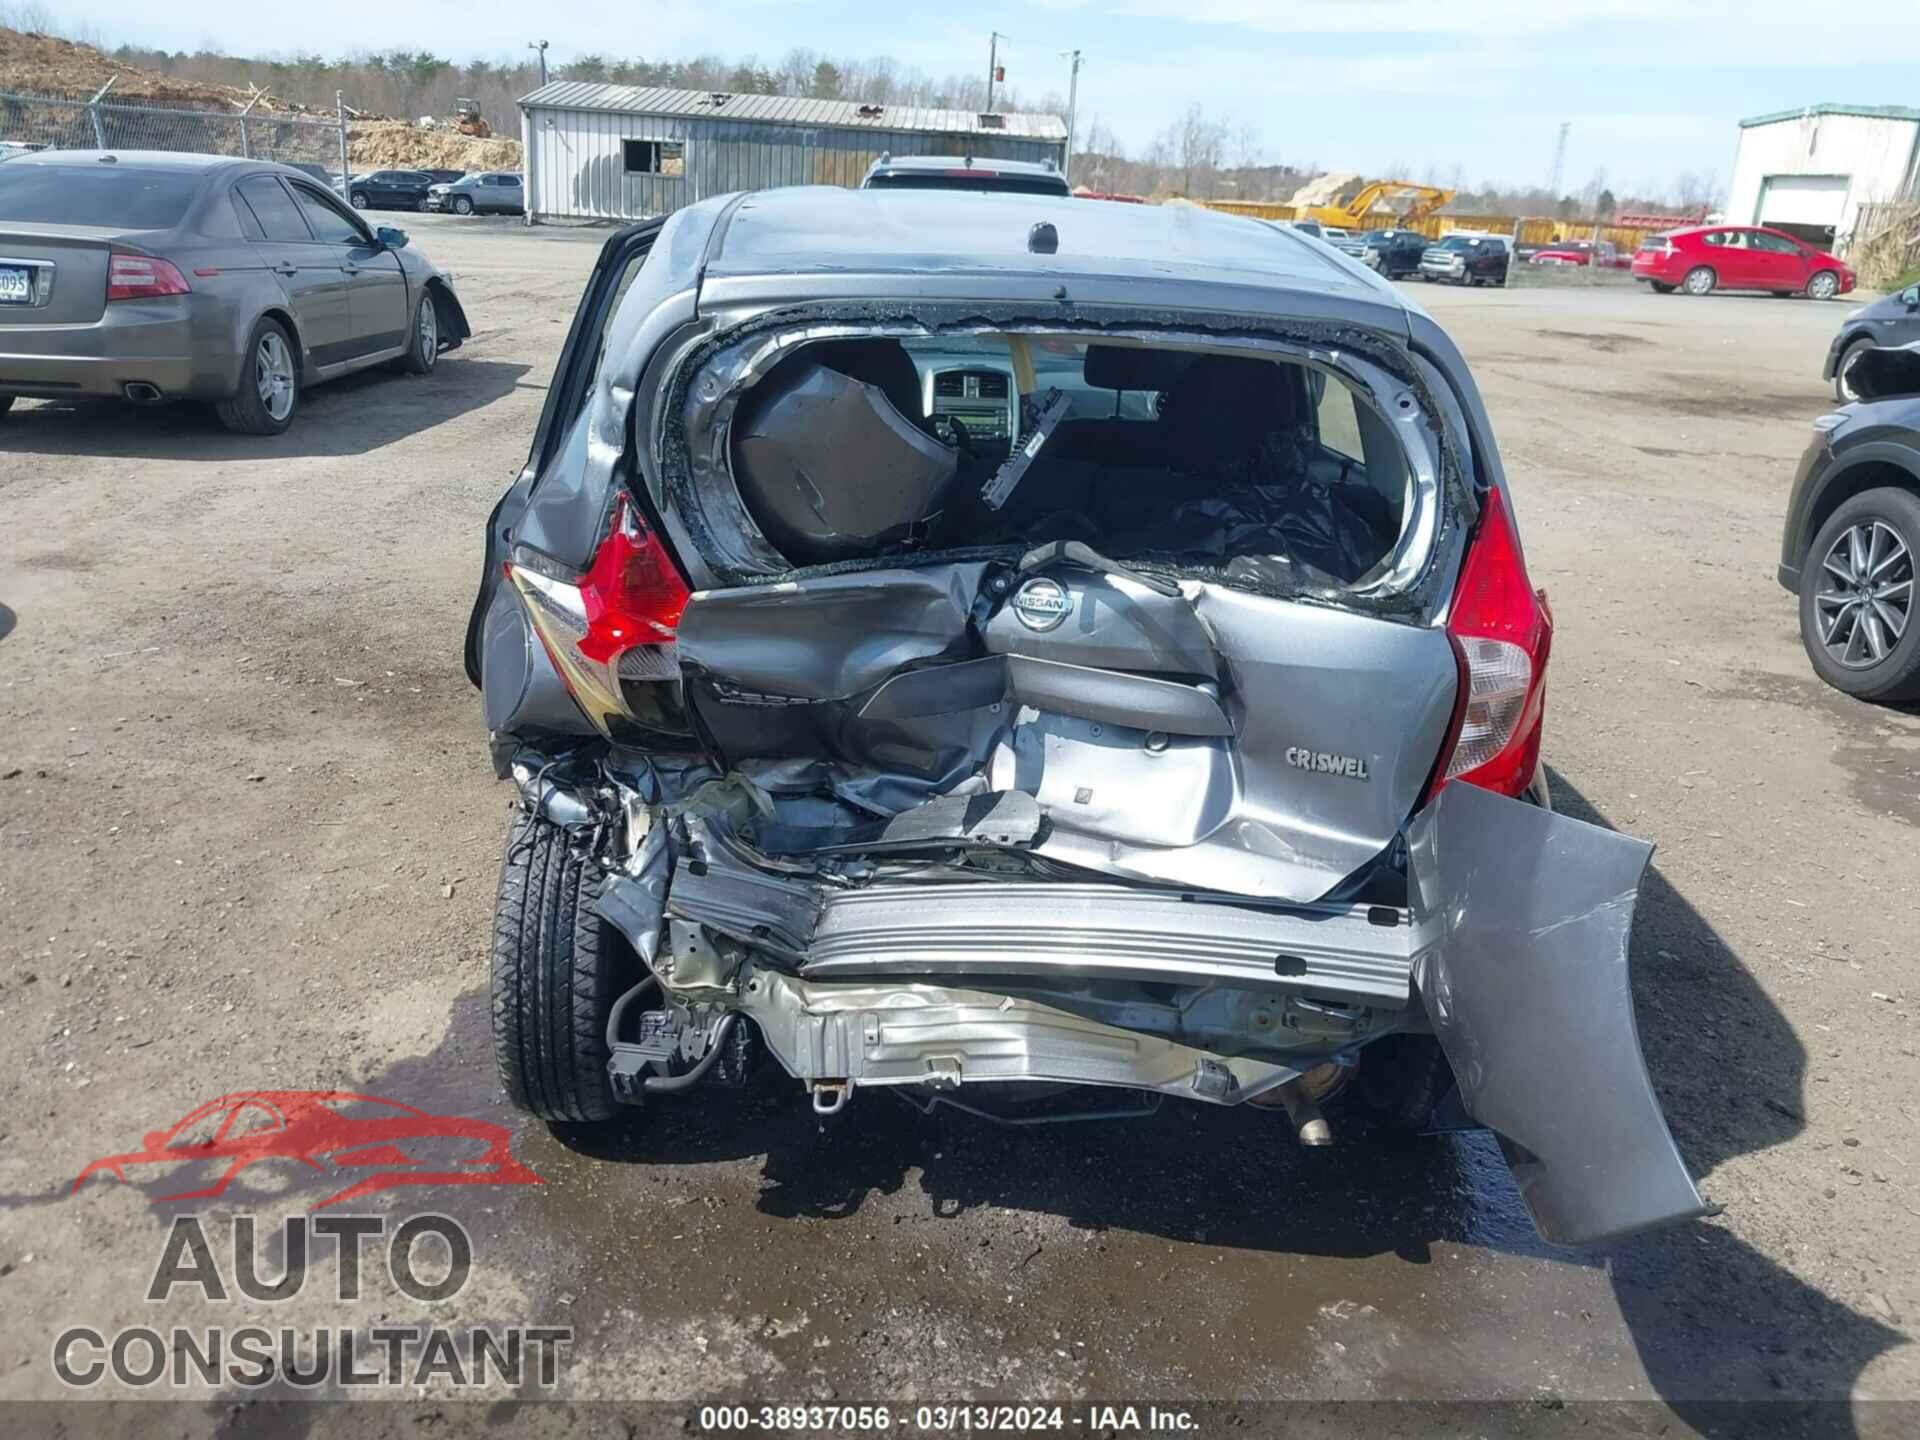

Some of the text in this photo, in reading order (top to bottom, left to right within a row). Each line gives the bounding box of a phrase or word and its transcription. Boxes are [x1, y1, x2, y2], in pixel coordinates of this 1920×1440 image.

[0, 275, 26, 291] 095
[1016, 596, 1064, 609] NISSAN
[1285, 747, 1367, 778] CRISWEL
